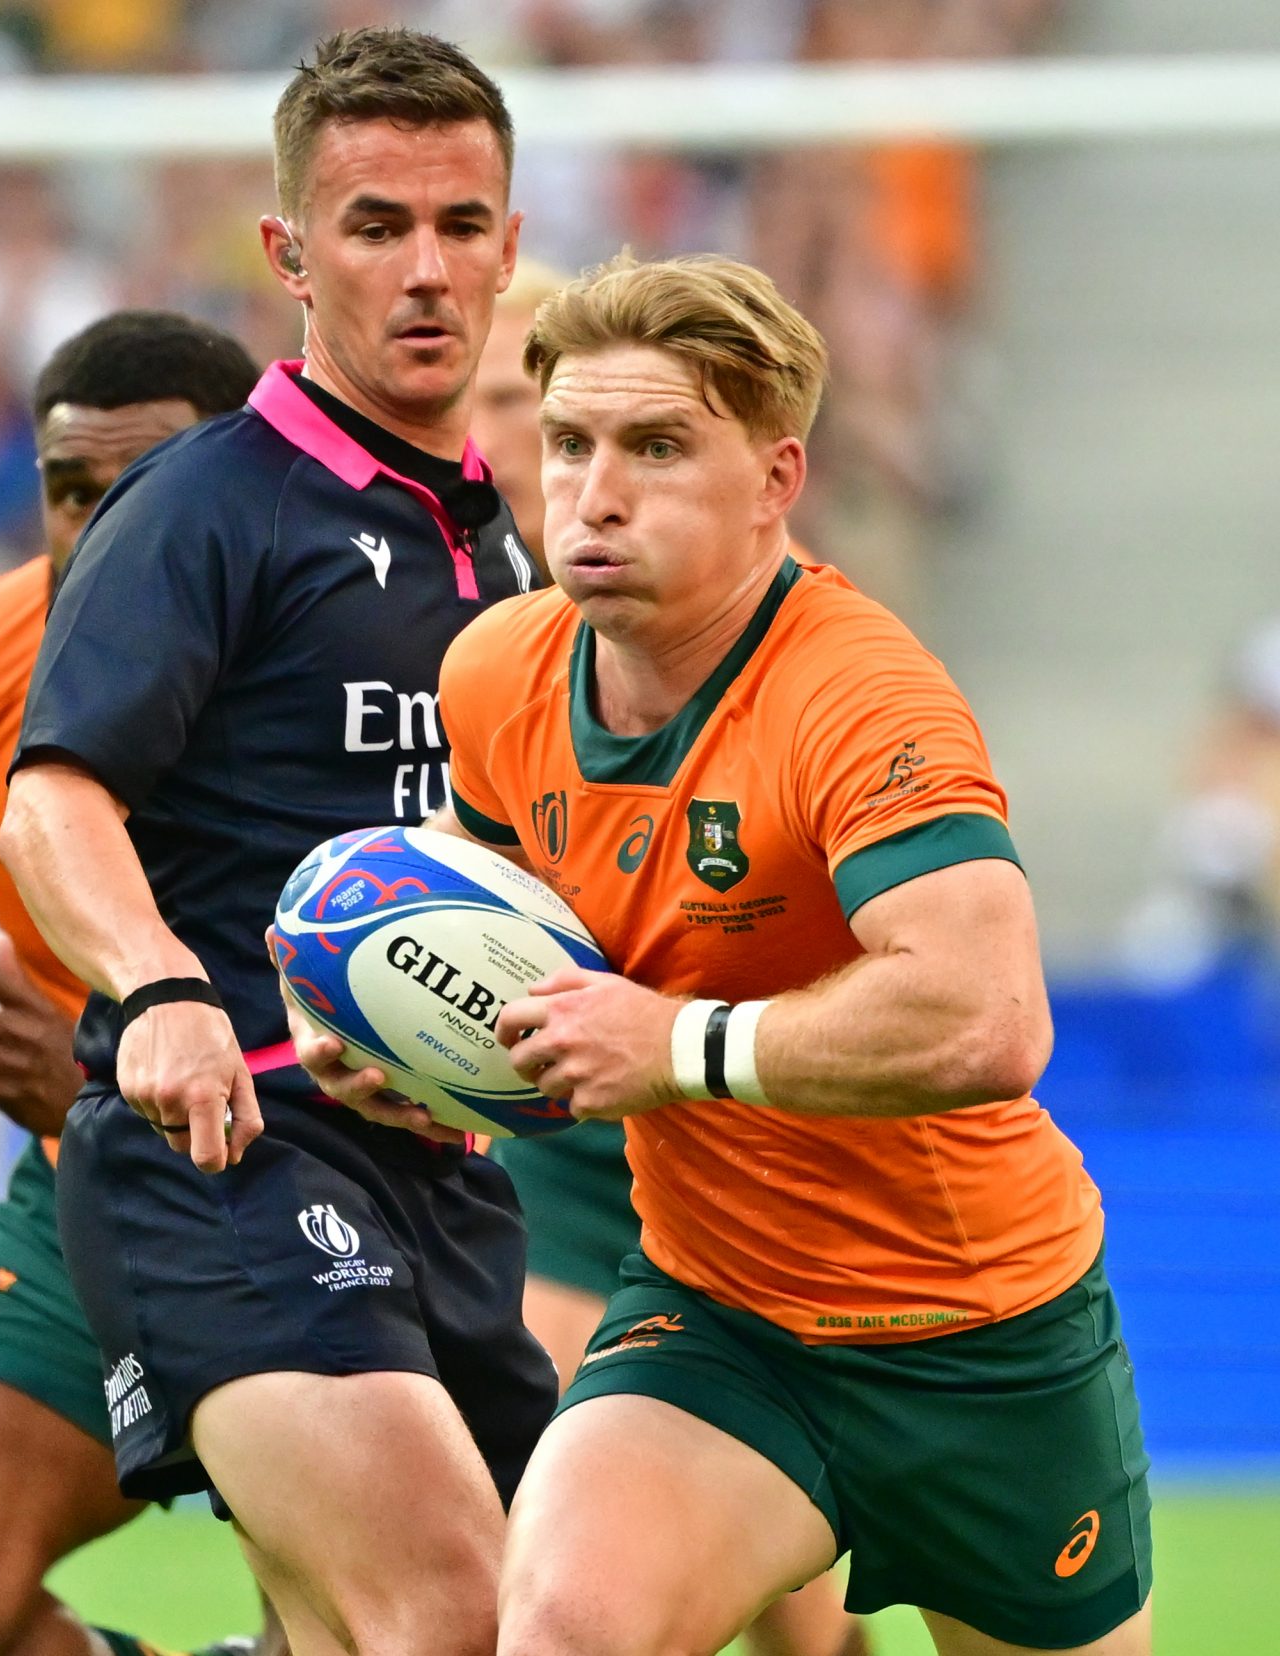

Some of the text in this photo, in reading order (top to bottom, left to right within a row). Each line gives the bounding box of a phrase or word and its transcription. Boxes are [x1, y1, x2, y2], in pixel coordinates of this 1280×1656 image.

[342, 681, 444, 752] Em
[341, 891, 365, 911] 2023
[680, 901, 729, 912] AUSTRALIA
[740, 895, 787, 909] GEORGIA
[758, 905, 786, 917] 2023
[723, 923, 754, 934] PARIS
[482, 933, 515, 957] AUSTRALIA
[520, 957, 545, 977] GEORGIA
[488, 956, 525, 984] SAINT-DENIS
[386, 935, 509, 1034] GILB
[416, 1030, 481, 1077] #RWC2023
[333, 1259, 366, 1269] RUGBY
[312, 1266, 394, 1285] WORLD CUP
[328, 1277, 391, 1292] FRANCE 2023
[856, 1316, 885, 1327] TATE
[123, 1386, 152, 1427] BETTER
